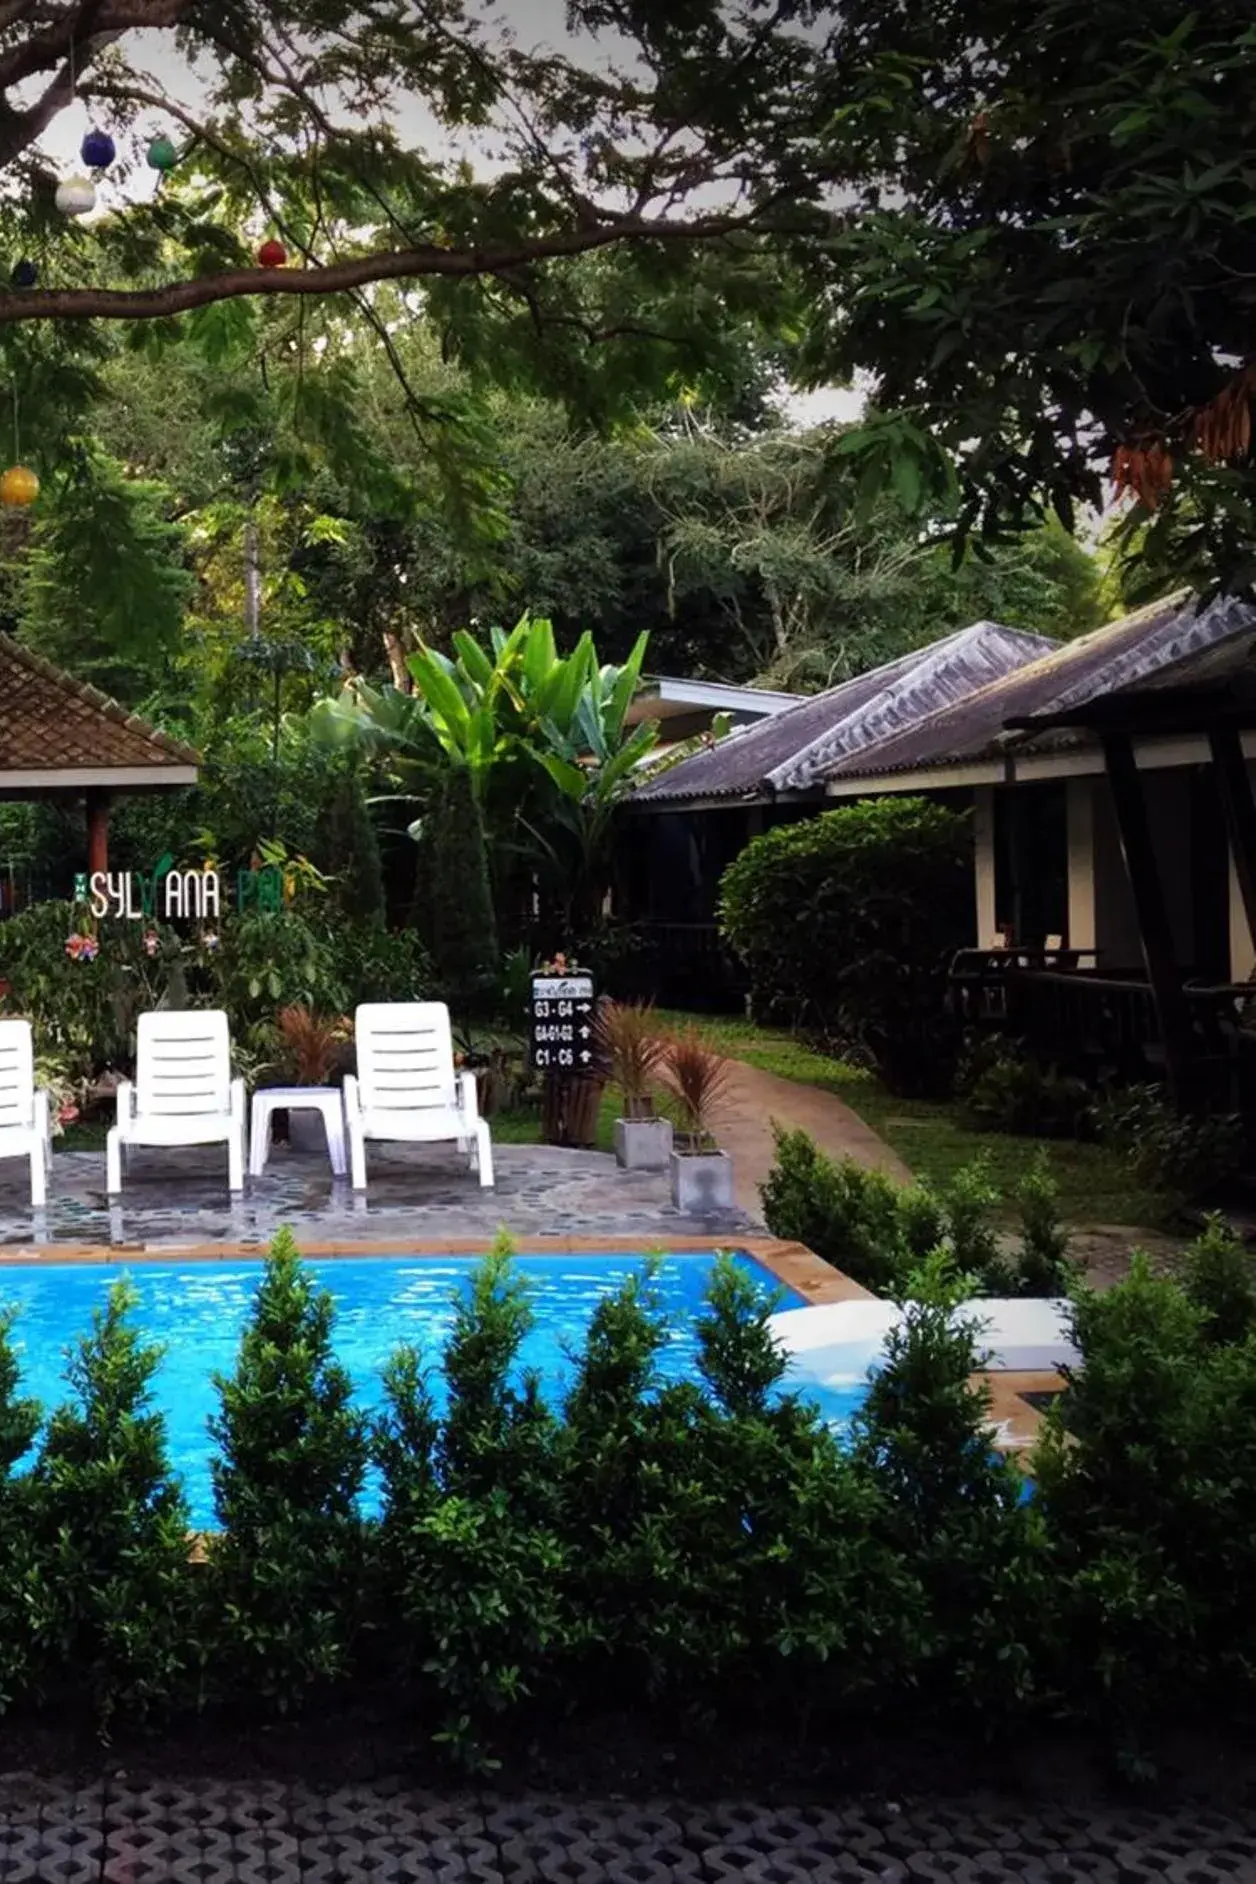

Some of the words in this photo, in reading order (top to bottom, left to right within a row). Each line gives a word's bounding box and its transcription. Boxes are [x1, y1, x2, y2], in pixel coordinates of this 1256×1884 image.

[535, 1001, 549, 1018] G3
[558, 1000, 573, 1018] G4
[536, 1048, 549, 1065] C1
